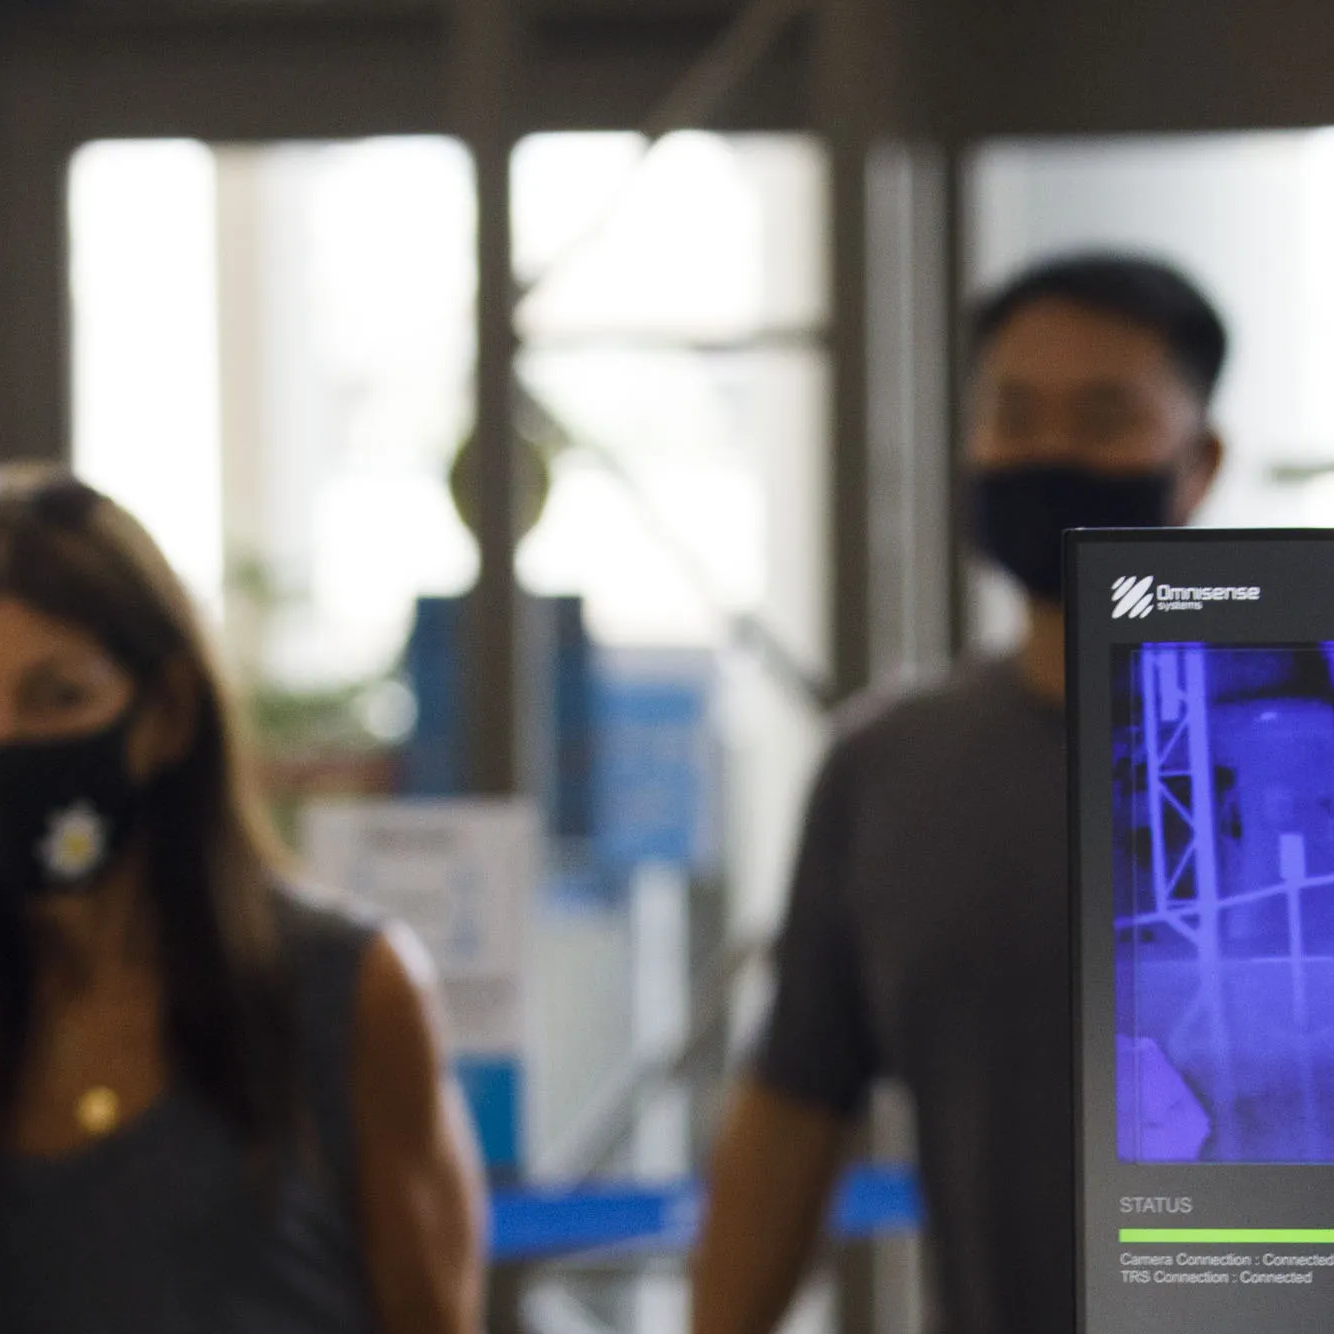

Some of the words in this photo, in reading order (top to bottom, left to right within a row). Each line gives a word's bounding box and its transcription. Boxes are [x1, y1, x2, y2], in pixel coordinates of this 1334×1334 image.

[1156, 584, 1261, 600] Omnisense
[1156, 600, 1203, 611] systems
[1119, 1196, 1193, 1213] STATUS
[1120, 1252, 1173, 1266] Camera
[1176, 1252, 1252, 1266] Connection
[1121, 1270, 1151, 1284] TRS
[1153, 1270, 1230, 1284] Connection
[1239, 1270, 1314, 1284] Connected
